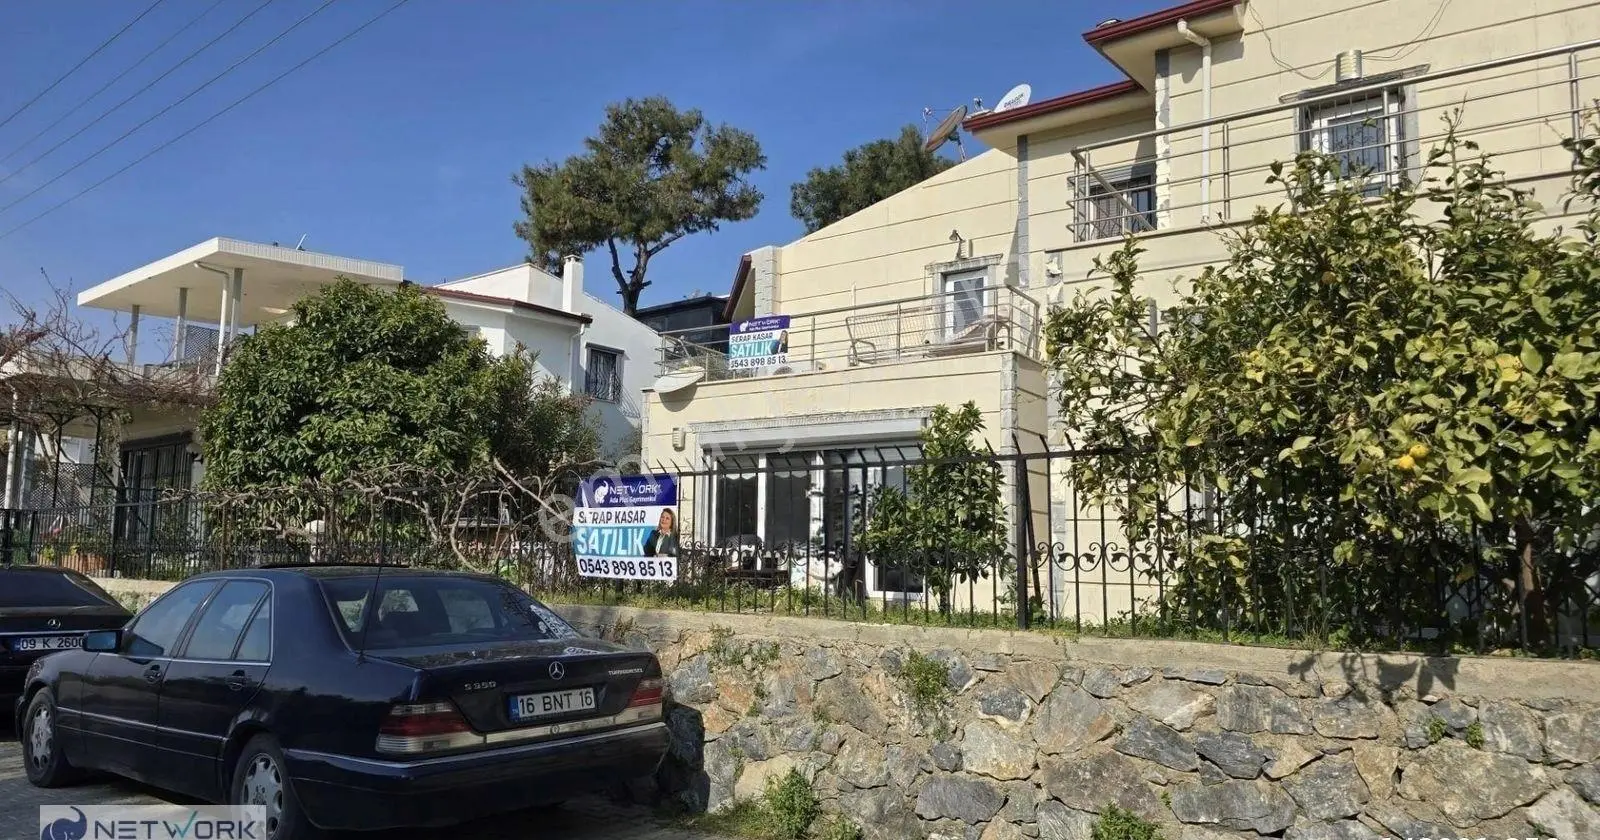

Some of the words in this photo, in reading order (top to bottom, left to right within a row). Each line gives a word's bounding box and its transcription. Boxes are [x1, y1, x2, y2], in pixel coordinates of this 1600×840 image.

[753, 332, 773, 341] KASAR
[731, 340, 772, 358] SATILIK
[750, 357, 765, 366] 898
[778, 355, 786, 364] 13
[609, 480, 658, 494] NETWORK
[615, 510, 646, 524] KASAR
[576, 527, 645, 556] SATILIK
[580, 558, 610, 575] 0543
[612, 560, 636, 576] 898
[639, 561, 656, 577] 85
[659, 561, 673, 577] 13
[21, 639, 36, 649] 09
[43, 639, 50, 648] K
[519, 697, 535, 715] 16
[543, 693, 573, 712] BNT
[579, 691, 593, 707] 16
